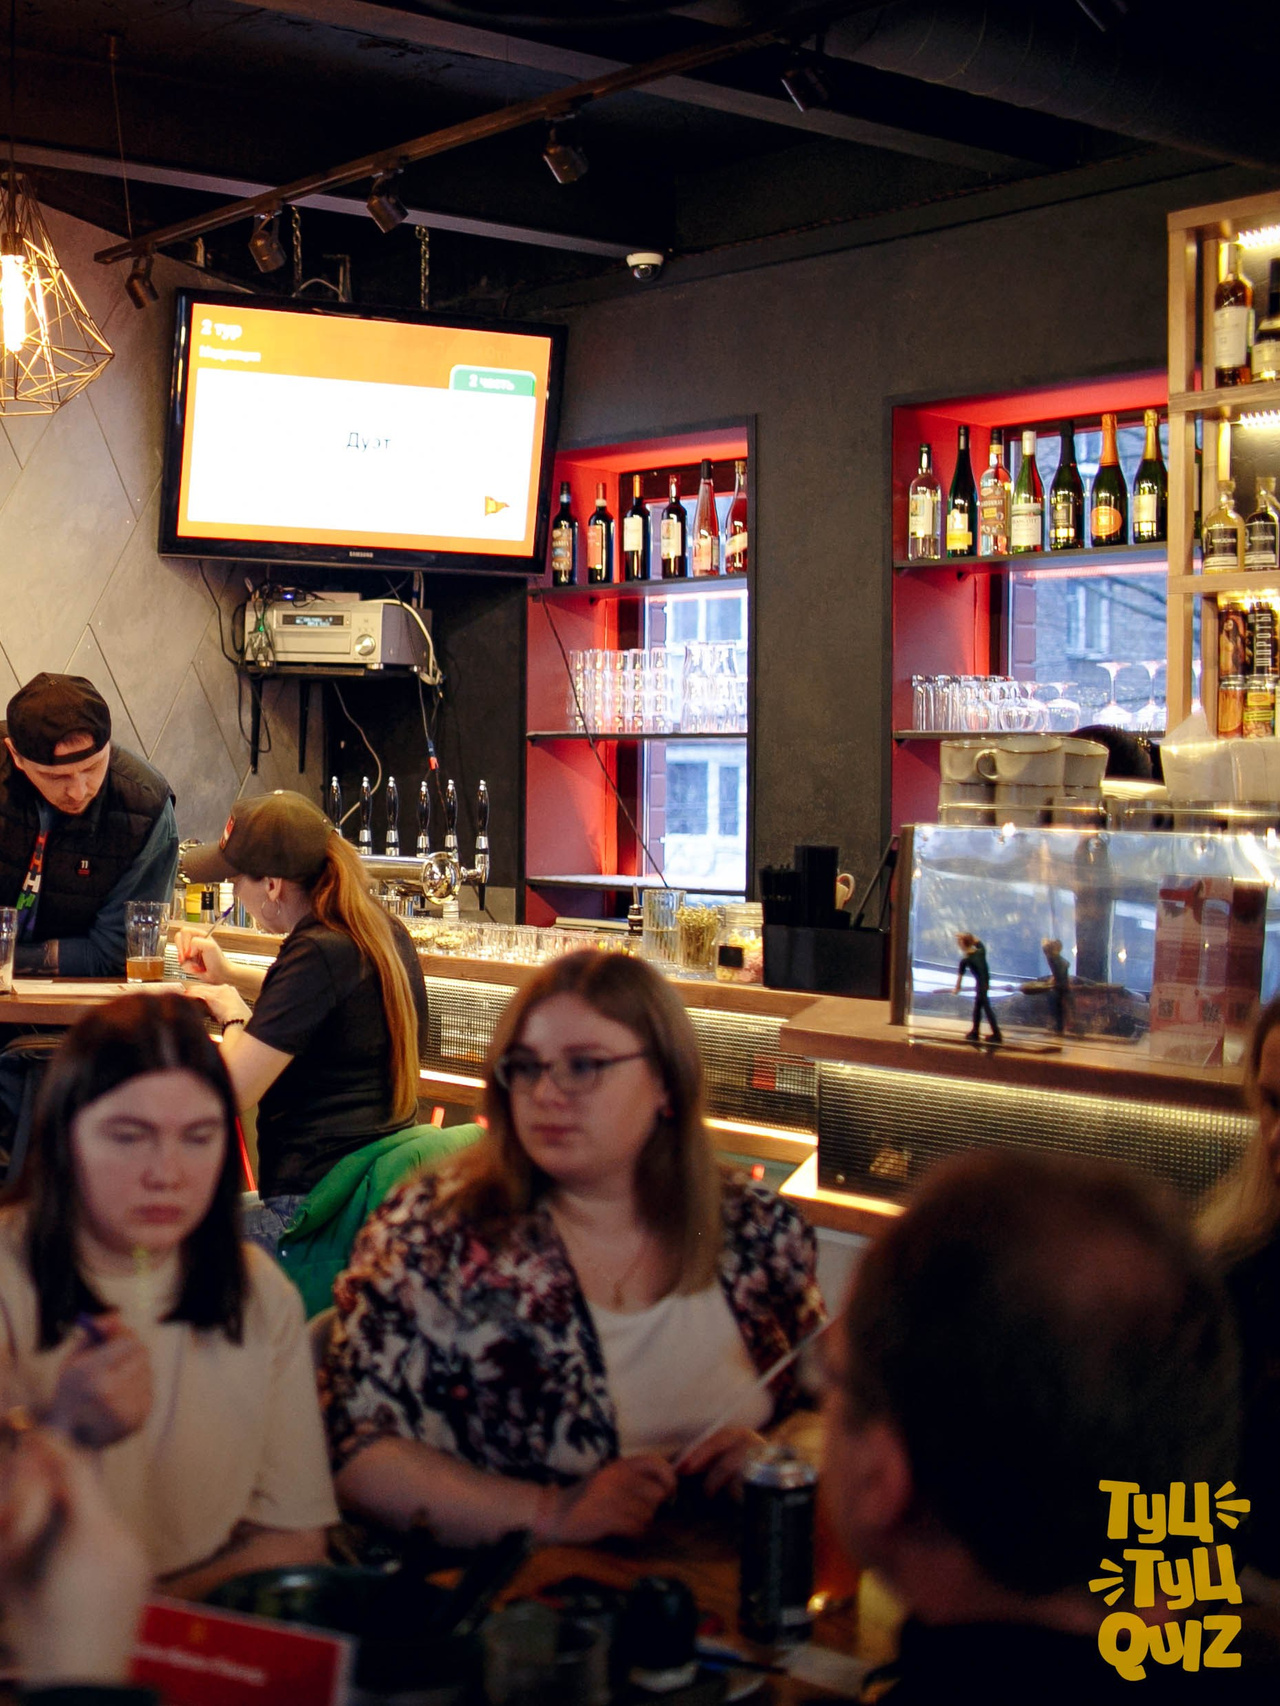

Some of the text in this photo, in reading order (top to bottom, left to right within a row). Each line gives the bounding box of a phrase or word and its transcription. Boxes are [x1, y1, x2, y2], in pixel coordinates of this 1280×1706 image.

[201, 319, 243, 341] 2 тур
[346, 432, 391, 453] Дуэт
[1255, 613, 1272, 667] ШПРОТЫ
